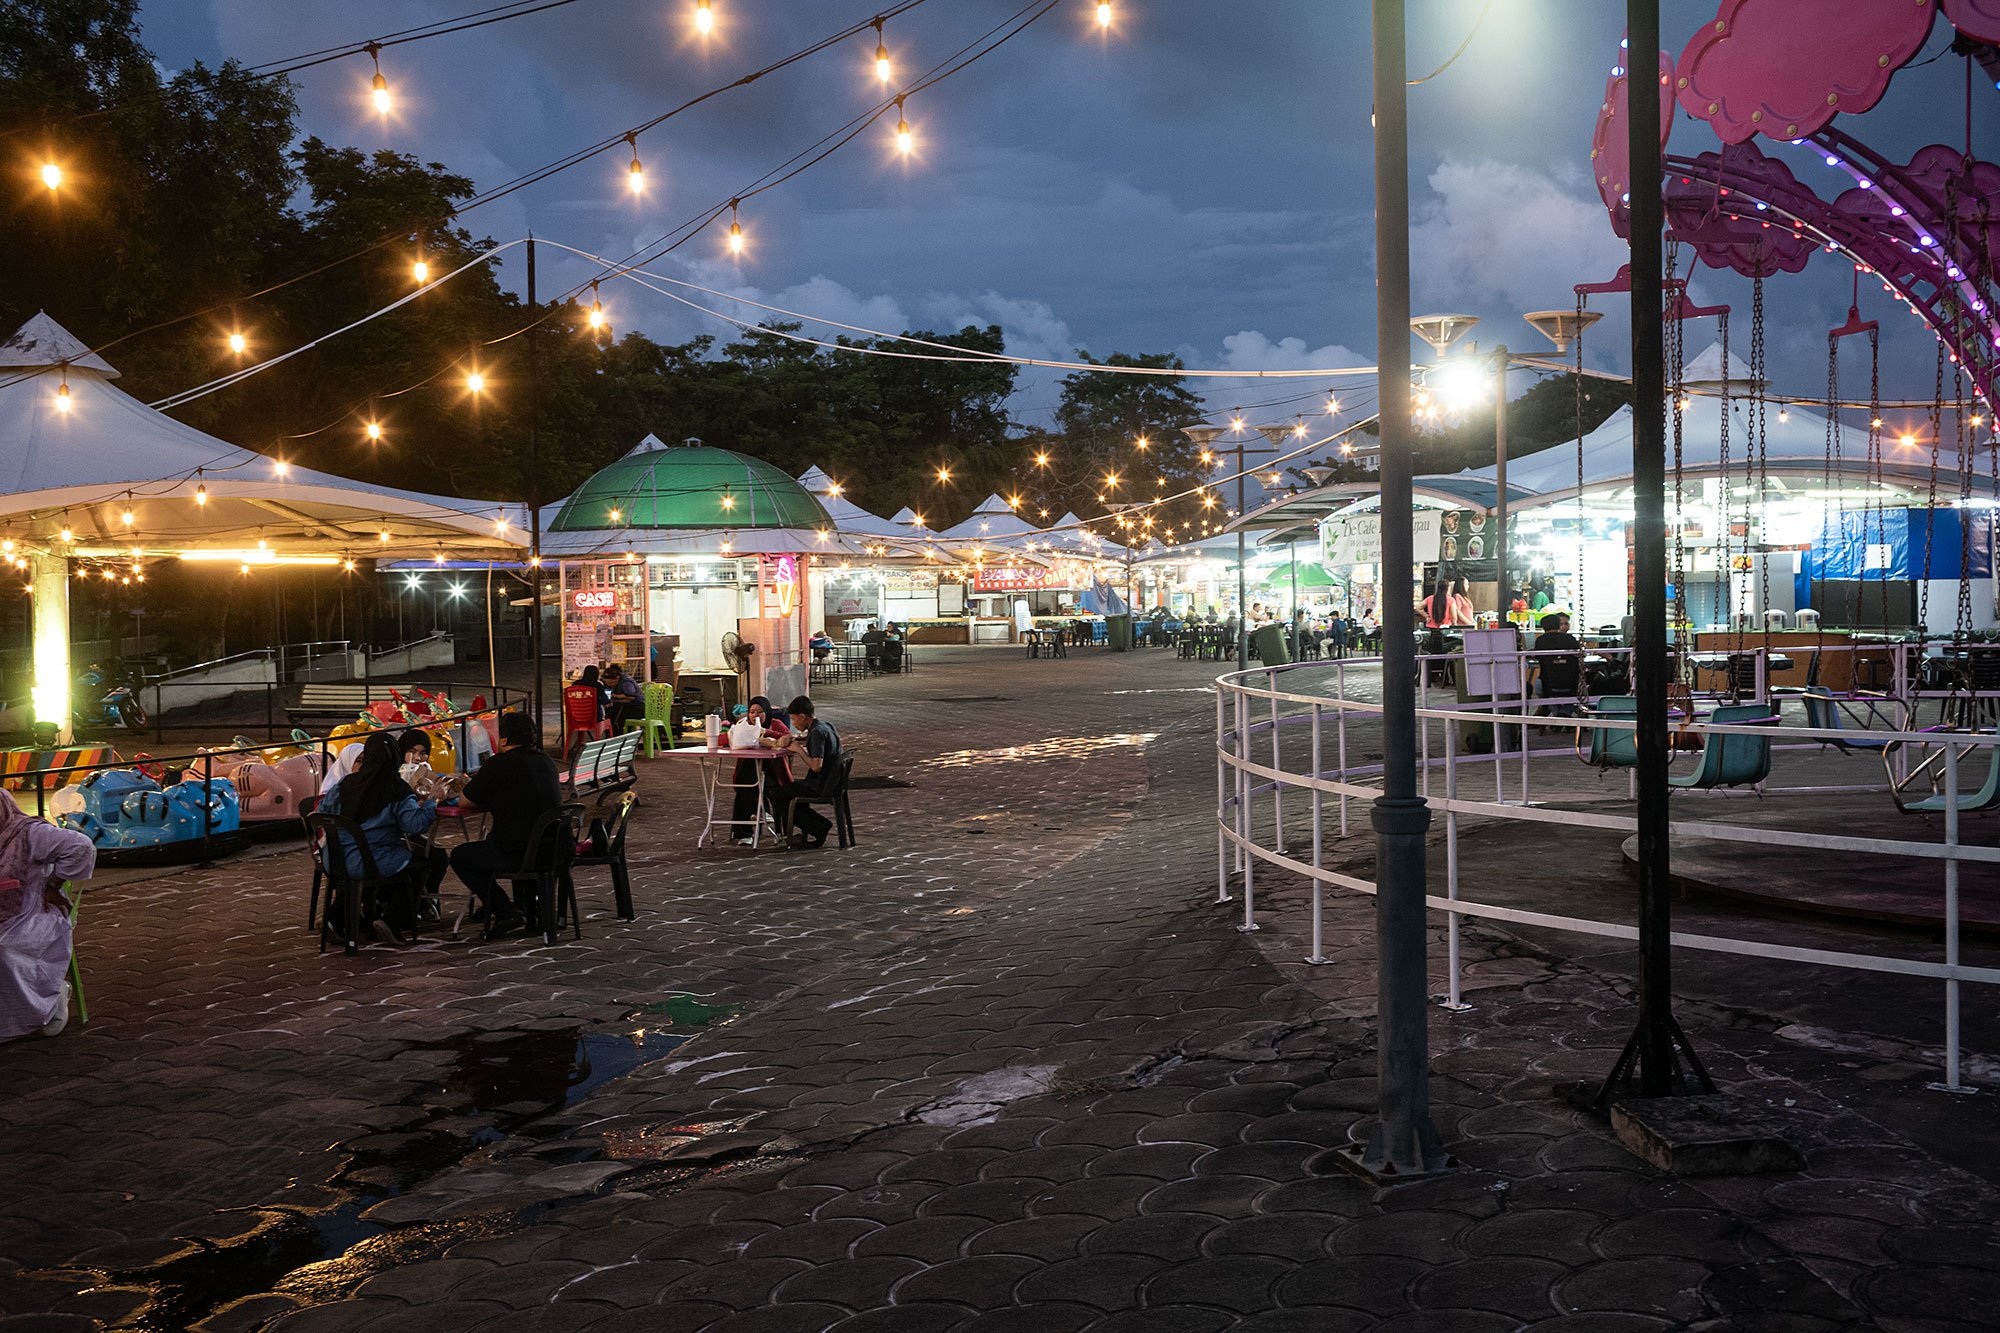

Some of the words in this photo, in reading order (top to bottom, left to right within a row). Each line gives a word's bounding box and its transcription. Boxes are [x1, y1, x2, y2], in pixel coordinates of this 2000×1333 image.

[1343, 521, 1357, 537] De
[1358, 519, 1378, 535] Cafe
[575, 592, 614, 607] CASH
